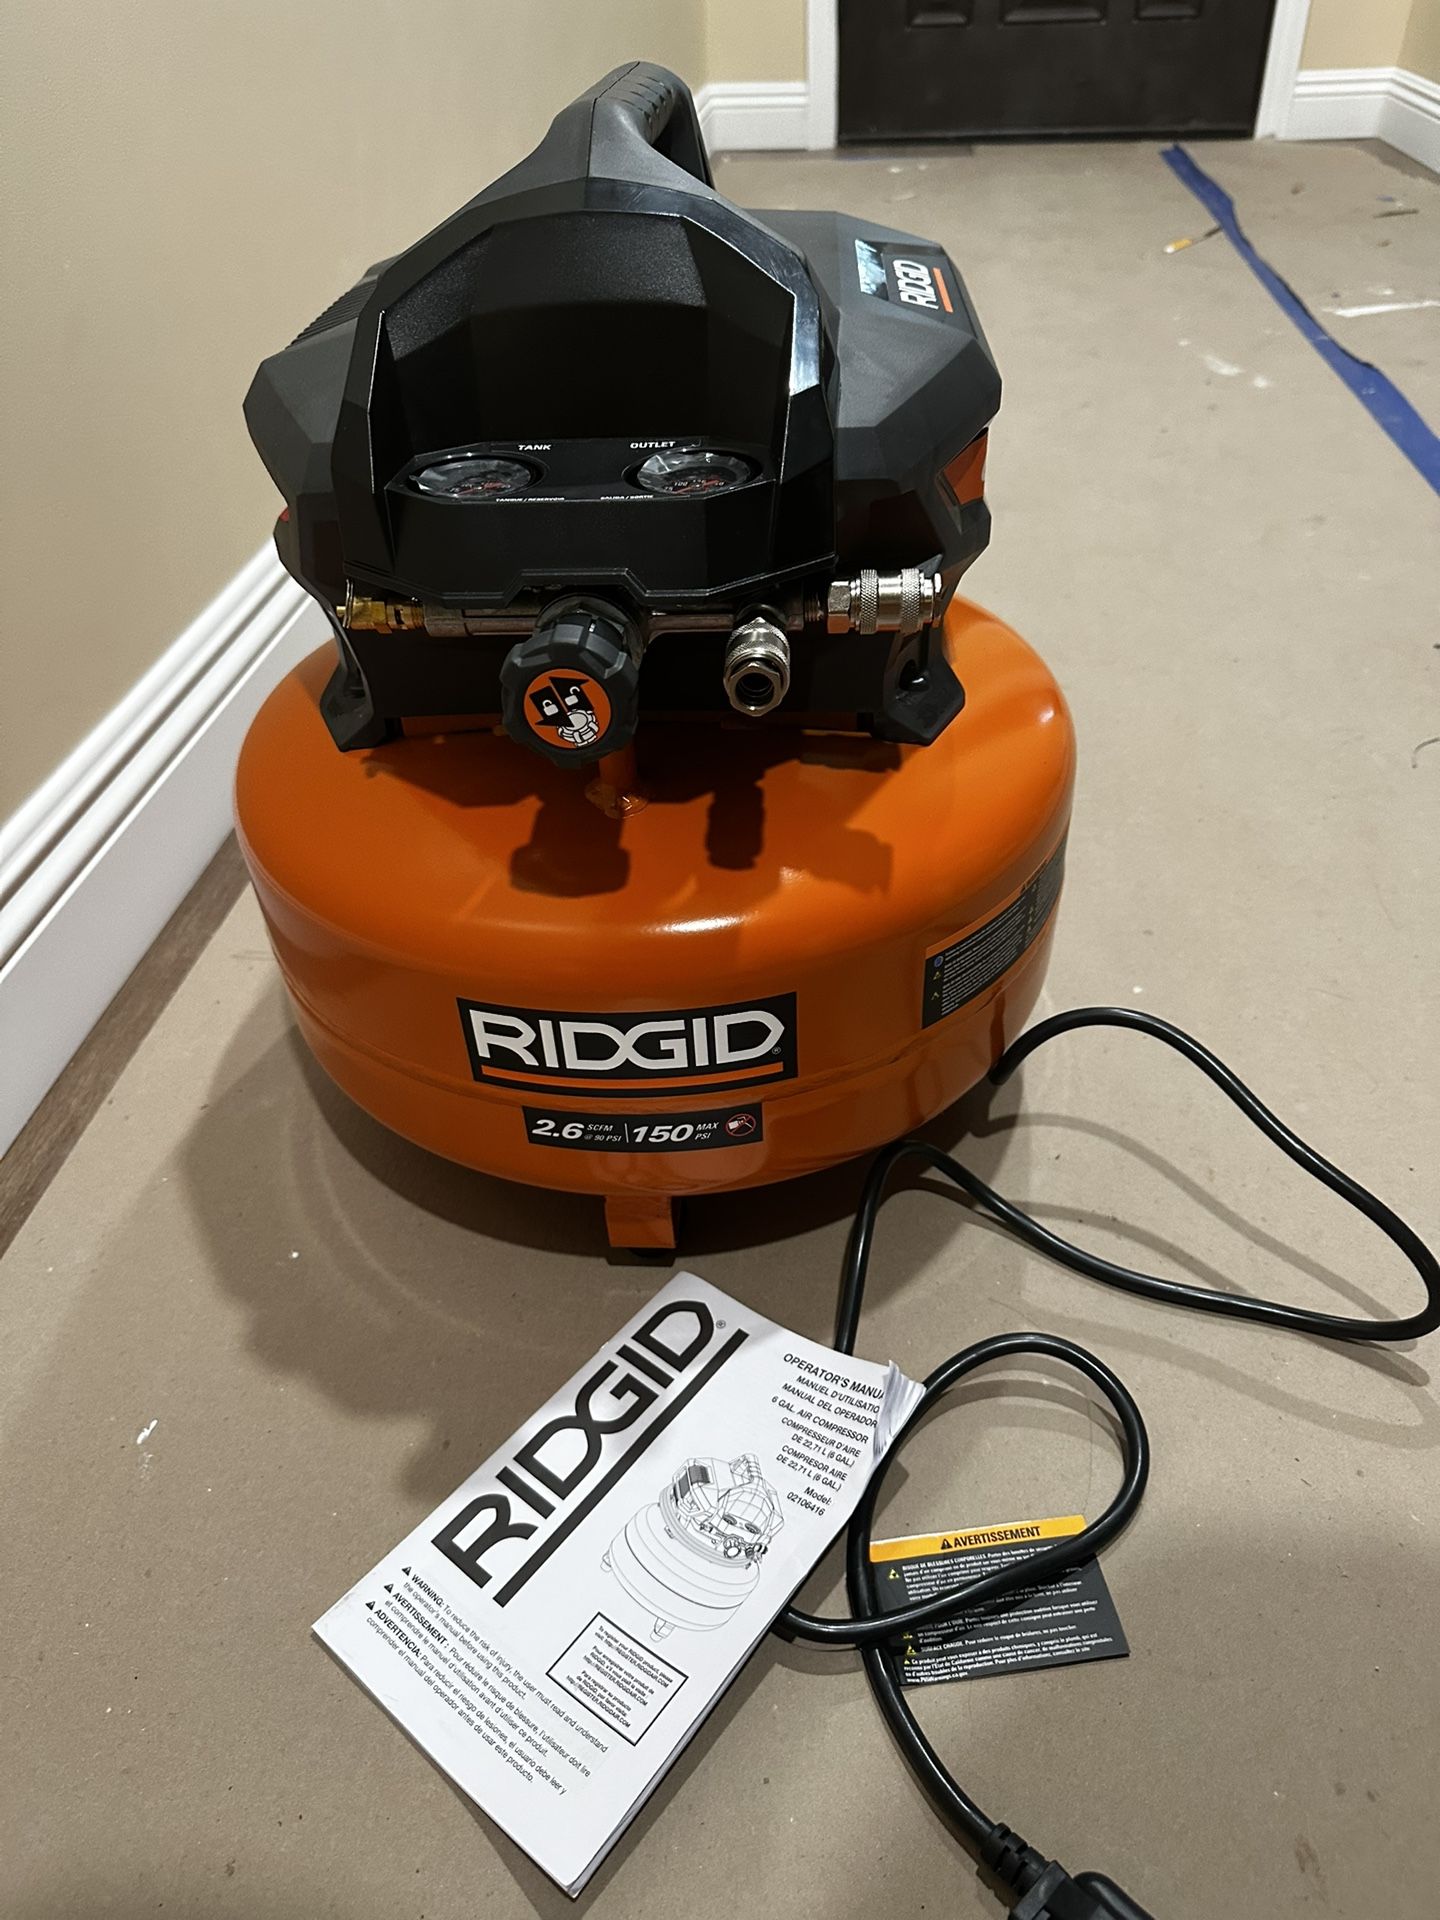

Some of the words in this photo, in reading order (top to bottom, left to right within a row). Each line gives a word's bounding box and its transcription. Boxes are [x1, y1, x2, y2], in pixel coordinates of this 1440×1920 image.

[630, 441, 675, 449] OUTLET
[532, 1119, 585, 1139] 2.6
[587, 1124, 614, 1132] SCFM
[632, 1124, 694, 1142] 150
[695, 1132, 711, 1140] PSI
[696, 1122, 719, 1130] MAX
[783, 1353, 850, 1388] OPERATOR'S
[781, 1382, 815, 1404] MANUAL
[816, 1399, 832, 1412] DEL
[833, 1406, 878, 1431] OPERADOR
[796, 1375, 829, 1396] MANUEL
[830, 1390, 880, 1418] D'UTILISATIO
[778, 1399, 795, 1413] GAL.
[796, 1409, 813, 1420] AIR
[812, 1415, 869, 1444] COMPRESSOR
[781, 1416, 836, 1447] COMPRESSEUR
[835, 1441, 861, 1458] D'AIRE
[781, 1444, 830, 1473] COMPRESOR
[828, 1468, 848, 1481] AIRE
[791, 1433, 803, 1444] DE
[802, 1438, 822, 1453] 22,71
[821, 1447, 826, 1456] L
[826, 1450, 836, 1459] (6
[835, 1453, 855, 1468] GAL.)
[775, 1453, 789, 1464] DE
[787, 1460, 807, 1474] 22,71
[806, 1469, 812, 1478] L
[812, 1472, 822, 1482] (6
[821, 1476, 842, 1492] GAL.)
[786, 1491, 826, 1516] 02106416
[803, 1486, 832, 1506] Model:
[953, 1525, 1041, 1548] AVERTISSEMENT
